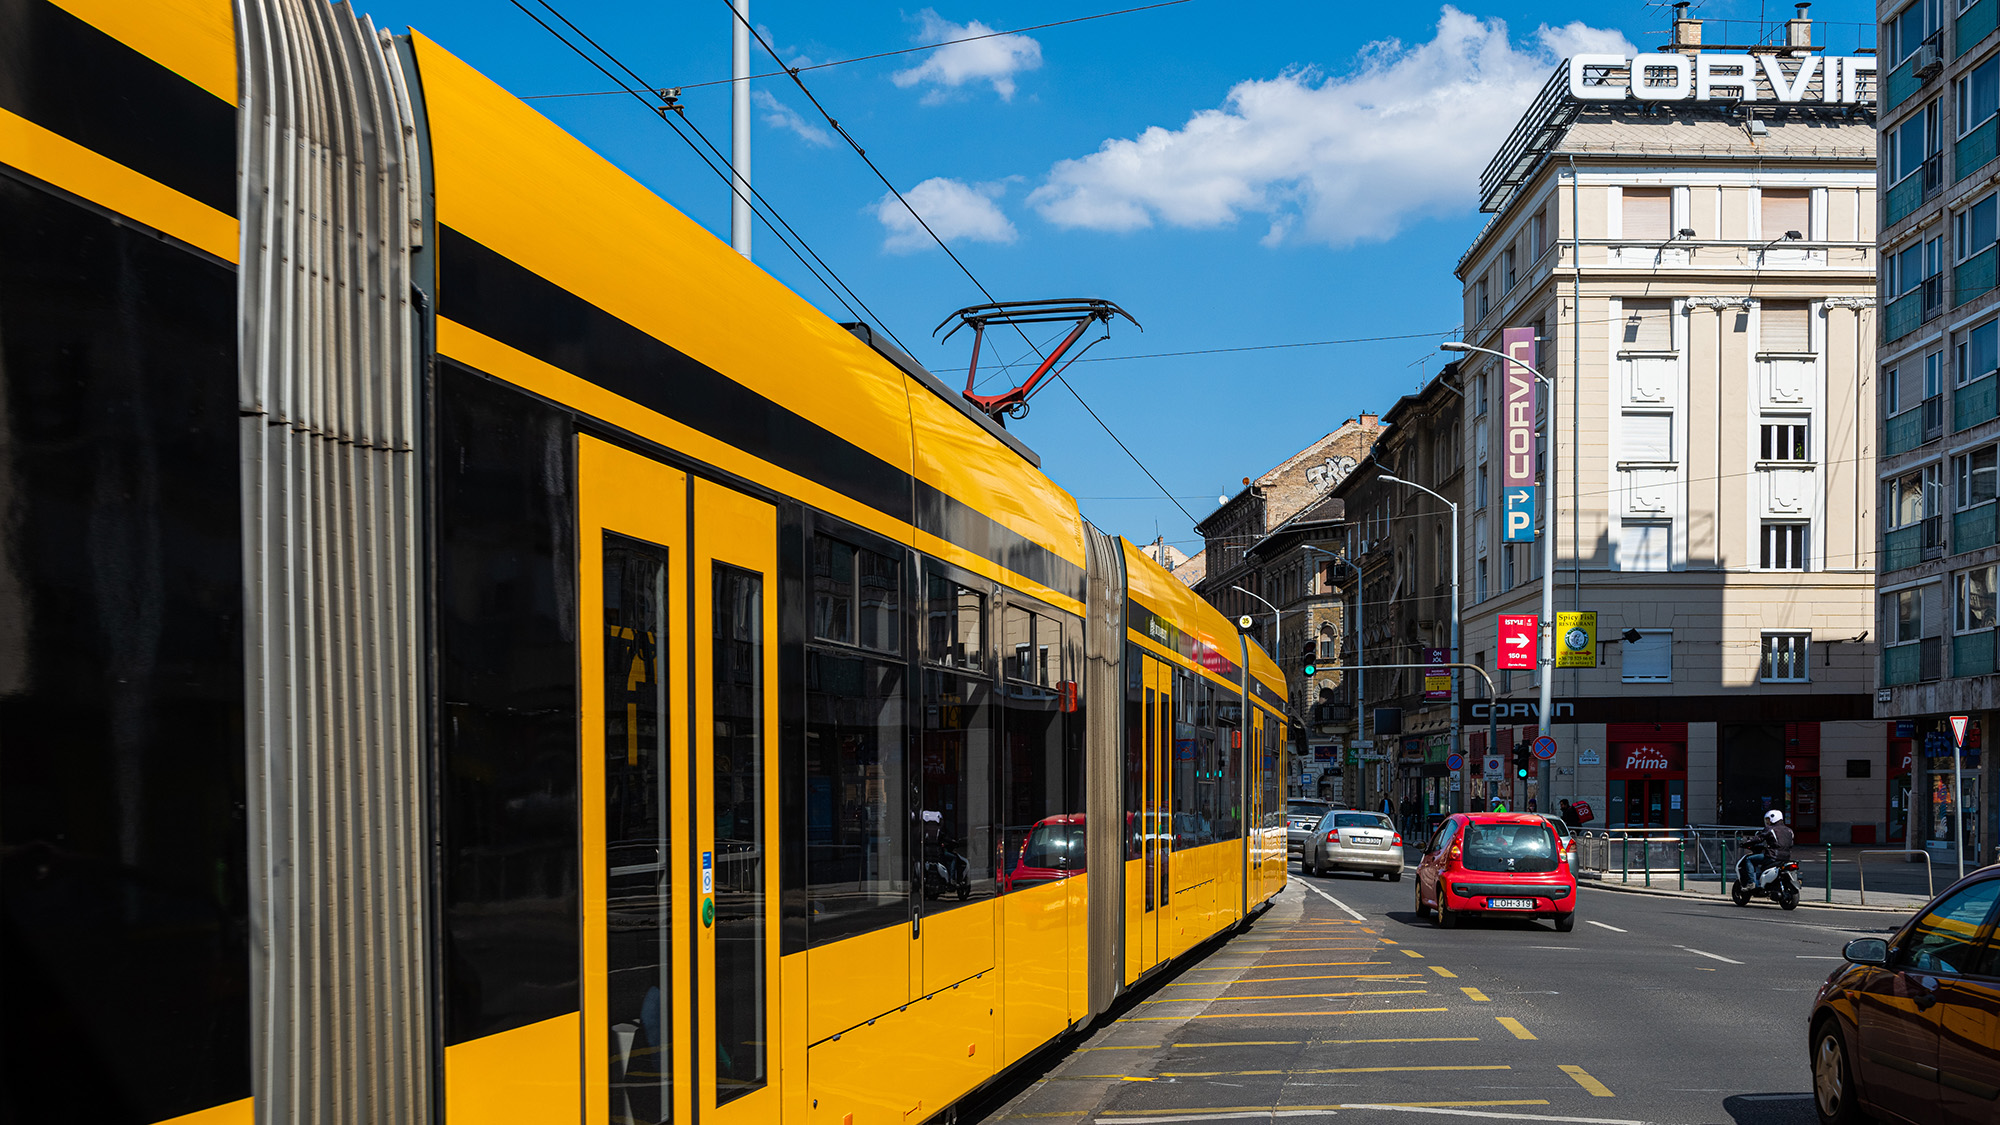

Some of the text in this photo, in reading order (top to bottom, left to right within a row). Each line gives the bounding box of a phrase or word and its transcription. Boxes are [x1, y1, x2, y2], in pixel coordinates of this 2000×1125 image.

[1509, 341, 1530, 479] CORVIN
[1508, 511, 1530, 539] P
[1558, 613, 1578, 622] Spicy
[1494, 899, 1531, 907] LOH-319
